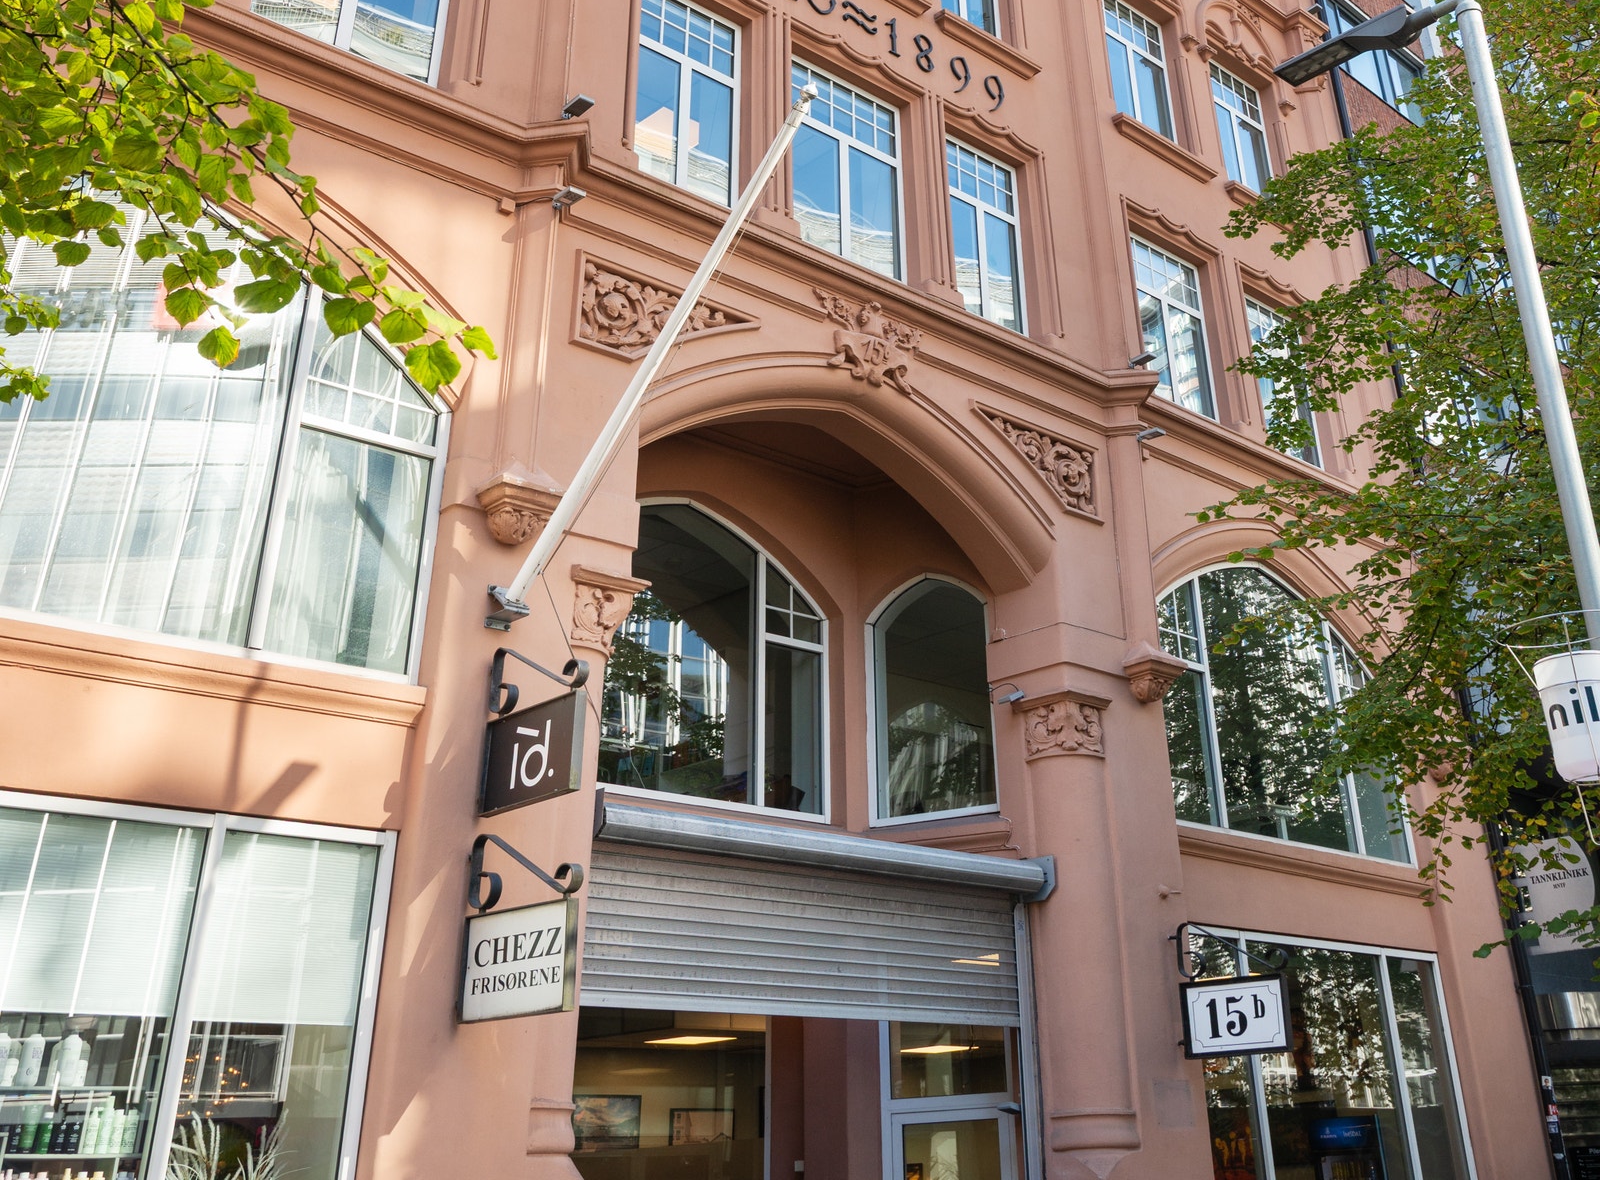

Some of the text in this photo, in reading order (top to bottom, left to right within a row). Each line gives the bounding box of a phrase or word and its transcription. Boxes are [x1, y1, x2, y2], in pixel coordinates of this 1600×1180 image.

[885, 18, 1006, 112] 1899
[1530, 867, 1589, 885] TANNKLINIKK
[474, 926, 563, 967] CHEZZ
[471, 965, 561, 996] FRISØRENE
